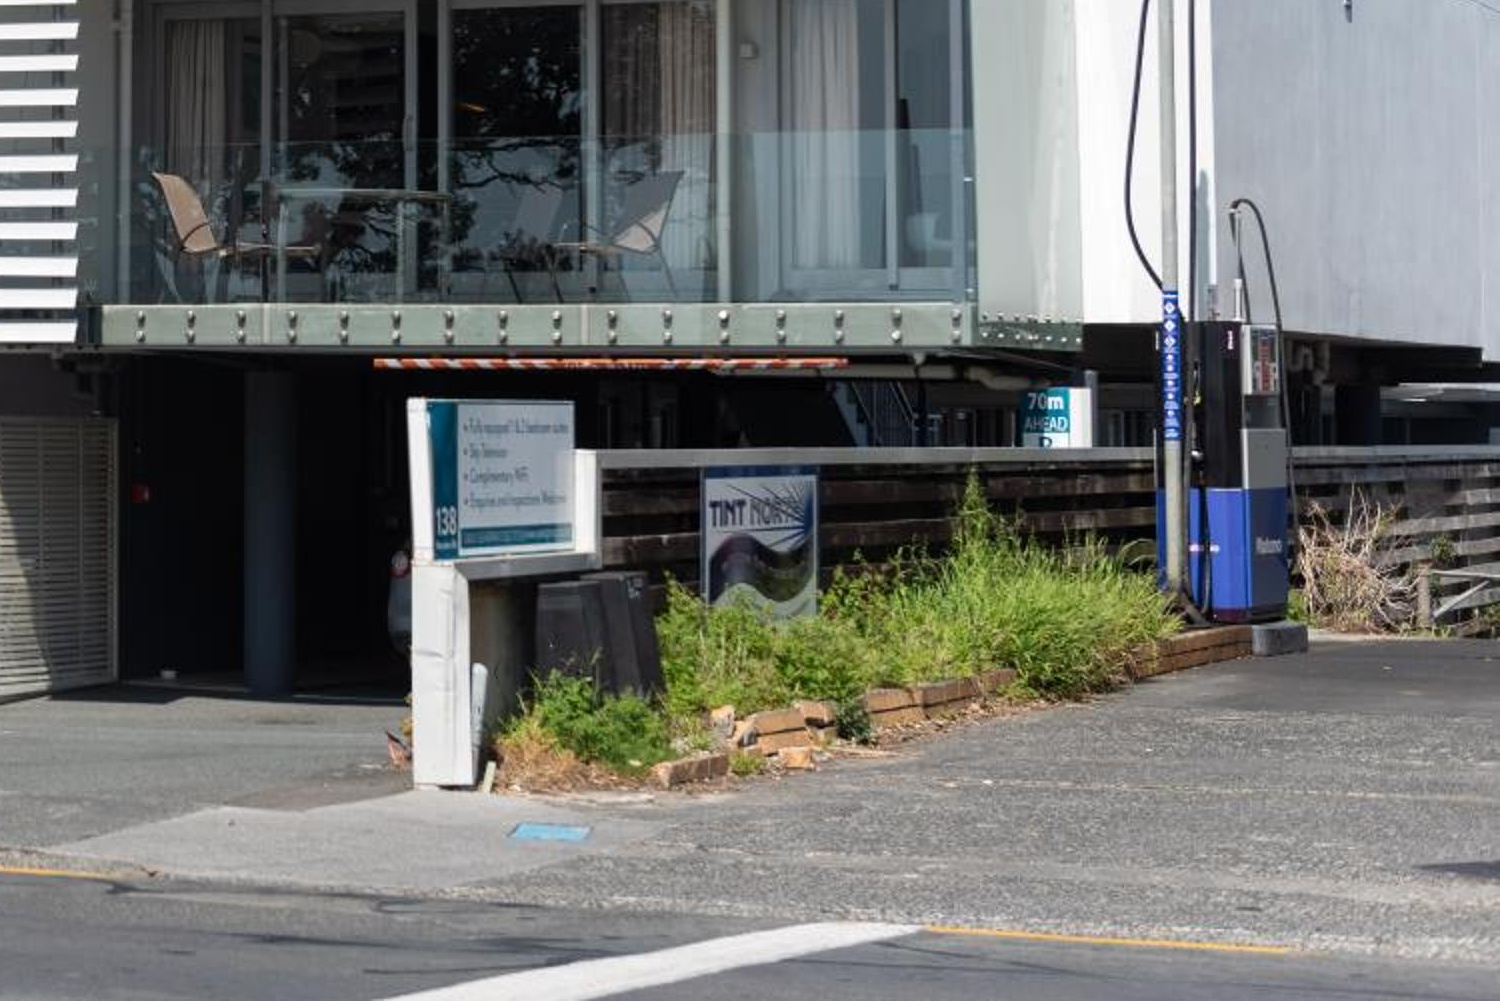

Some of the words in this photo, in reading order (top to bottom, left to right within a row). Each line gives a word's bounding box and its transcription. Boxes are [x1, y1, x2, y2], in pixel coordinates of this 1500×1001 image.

[1028, 392, 1065, 410] 70m
[1025, 416, 1069, 432] AHEAD
[436, 506, 457, 536] 138
[708, 499, 746, 527] TINT
